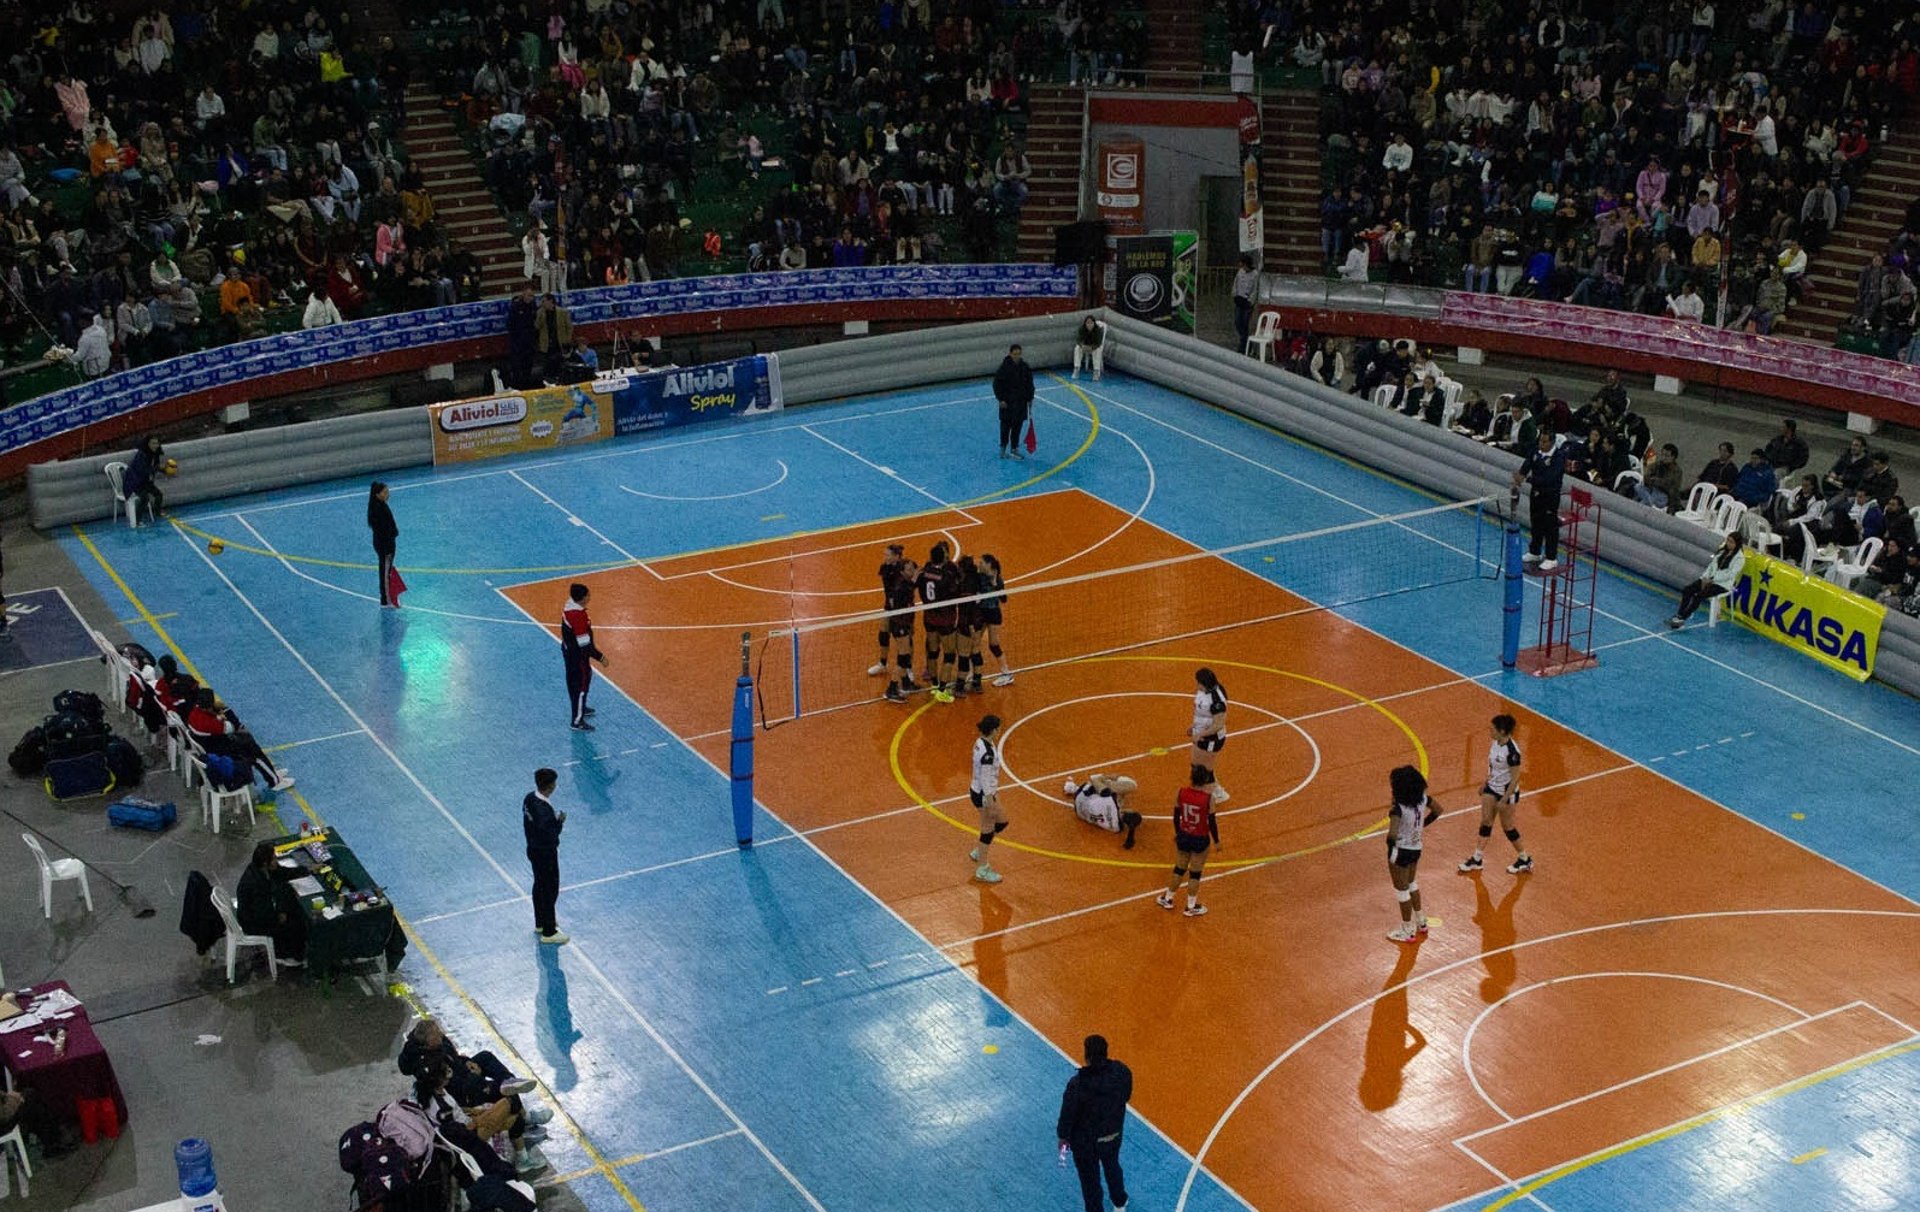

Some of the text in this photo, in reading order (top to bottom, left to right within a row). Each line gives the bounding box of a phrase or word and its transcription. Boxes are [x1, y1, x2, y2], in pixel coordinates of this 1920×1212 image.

[662, 365, 735, 398] Aliviol
[450, 404, 499, 423] Aliviol
[690, 393, 737, 413] Spray
[926, 581, 936, 601] 6
[1726, 570, 1868, 671] MIKASA
[1182, 803, 1201, 825] 15
